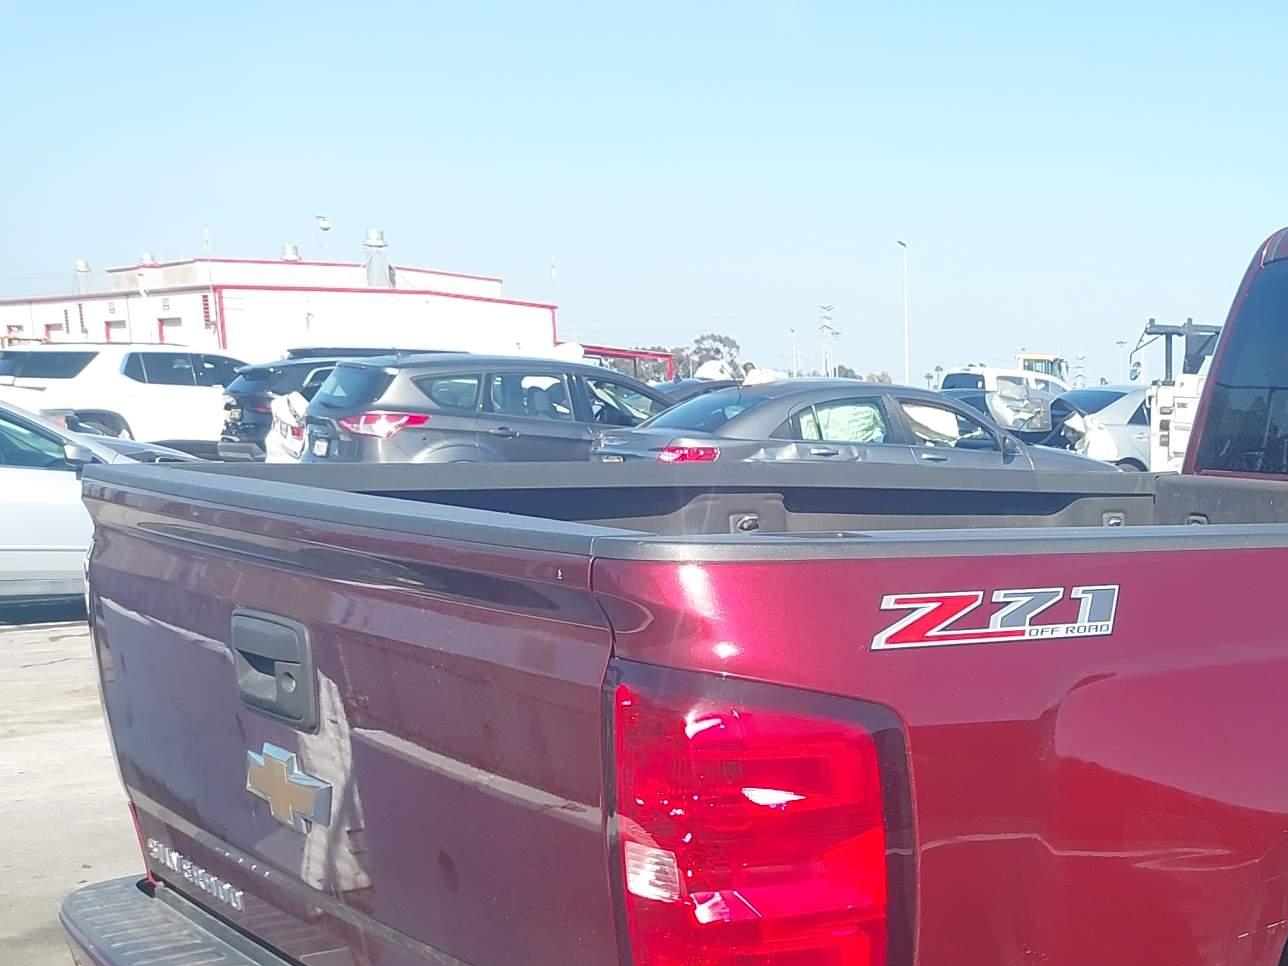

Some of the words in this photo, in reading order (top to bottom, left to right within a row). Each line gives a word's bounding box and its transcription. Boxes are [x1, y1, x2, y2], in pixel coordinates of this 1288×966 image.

[870, 584, 1120, 650] Z71
[1028, 627, 1062, 637] OFF
[1065, 624, 1110, 635] ROAD
